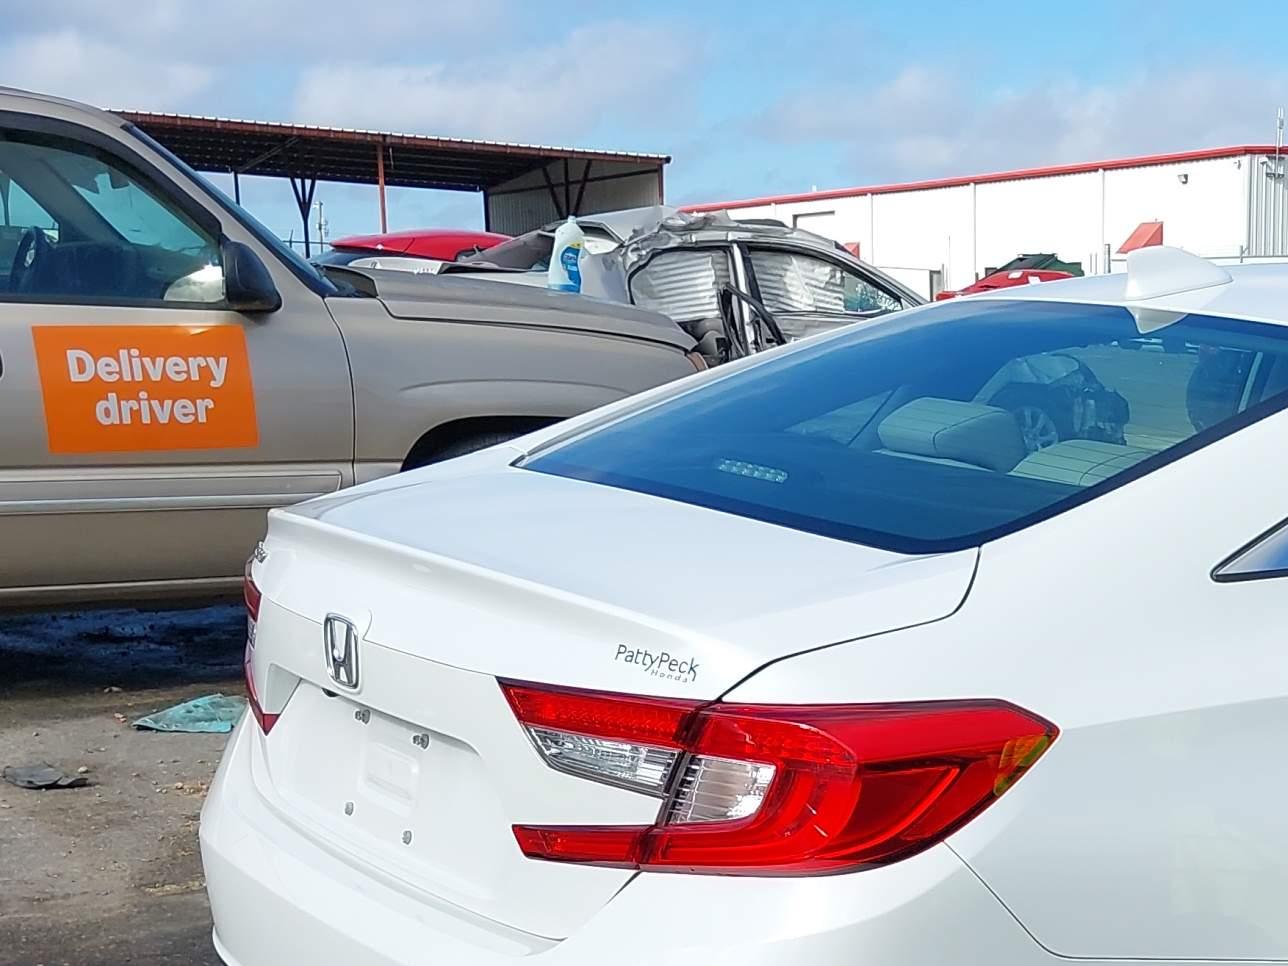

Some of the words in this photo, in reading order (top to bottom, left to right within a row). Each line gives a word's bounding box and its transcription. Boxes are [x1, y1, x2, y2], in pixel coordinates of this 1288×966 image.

[66, 348, 228, 388] Delivery
[95, 391, 214, 425] driver
[615, 644, 699, 682] PattyPeck
[650, 669, 688, 683] Honda
